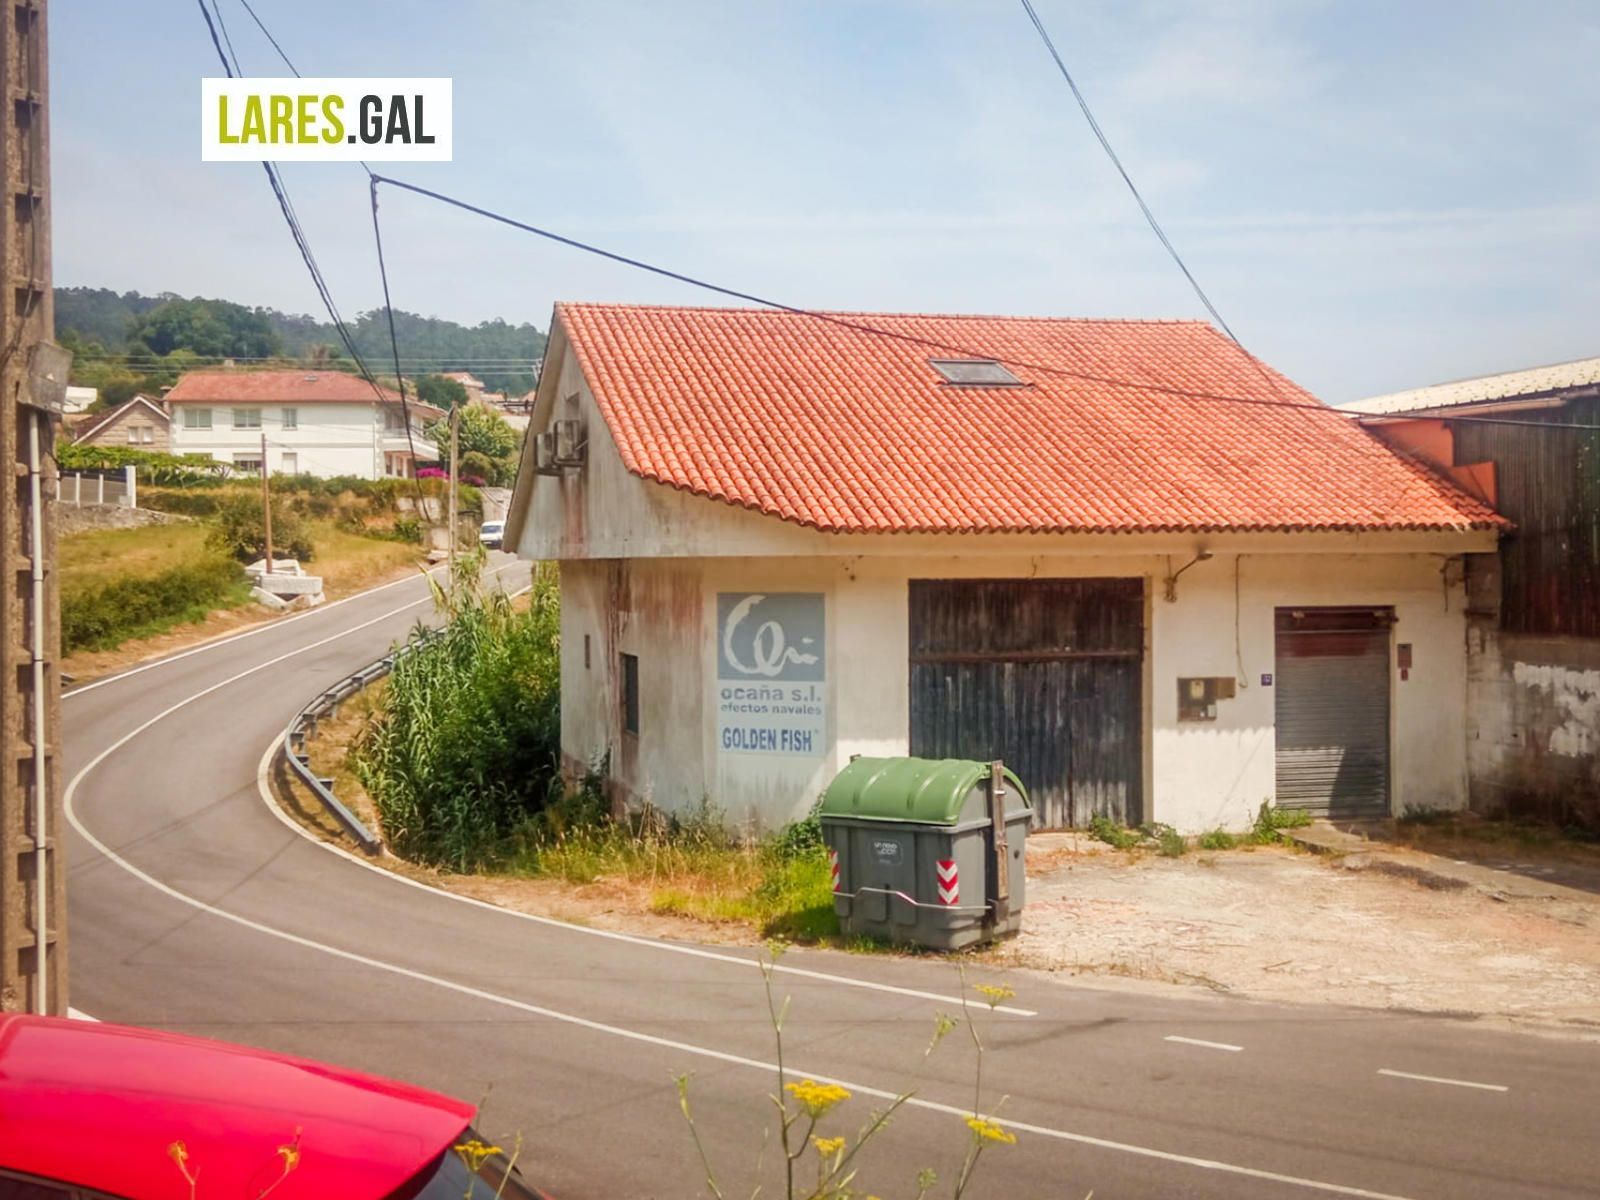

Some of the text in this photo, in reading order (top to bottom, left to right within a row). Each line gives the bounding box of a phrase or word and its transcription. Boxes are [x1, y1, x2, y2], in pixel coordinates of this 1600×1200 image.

[720, 684, 822, 702] ocaña s.l.
[720, 702, 822, 715] efectos navales
[722, 727, 812, 752] GOLDEN FISH
